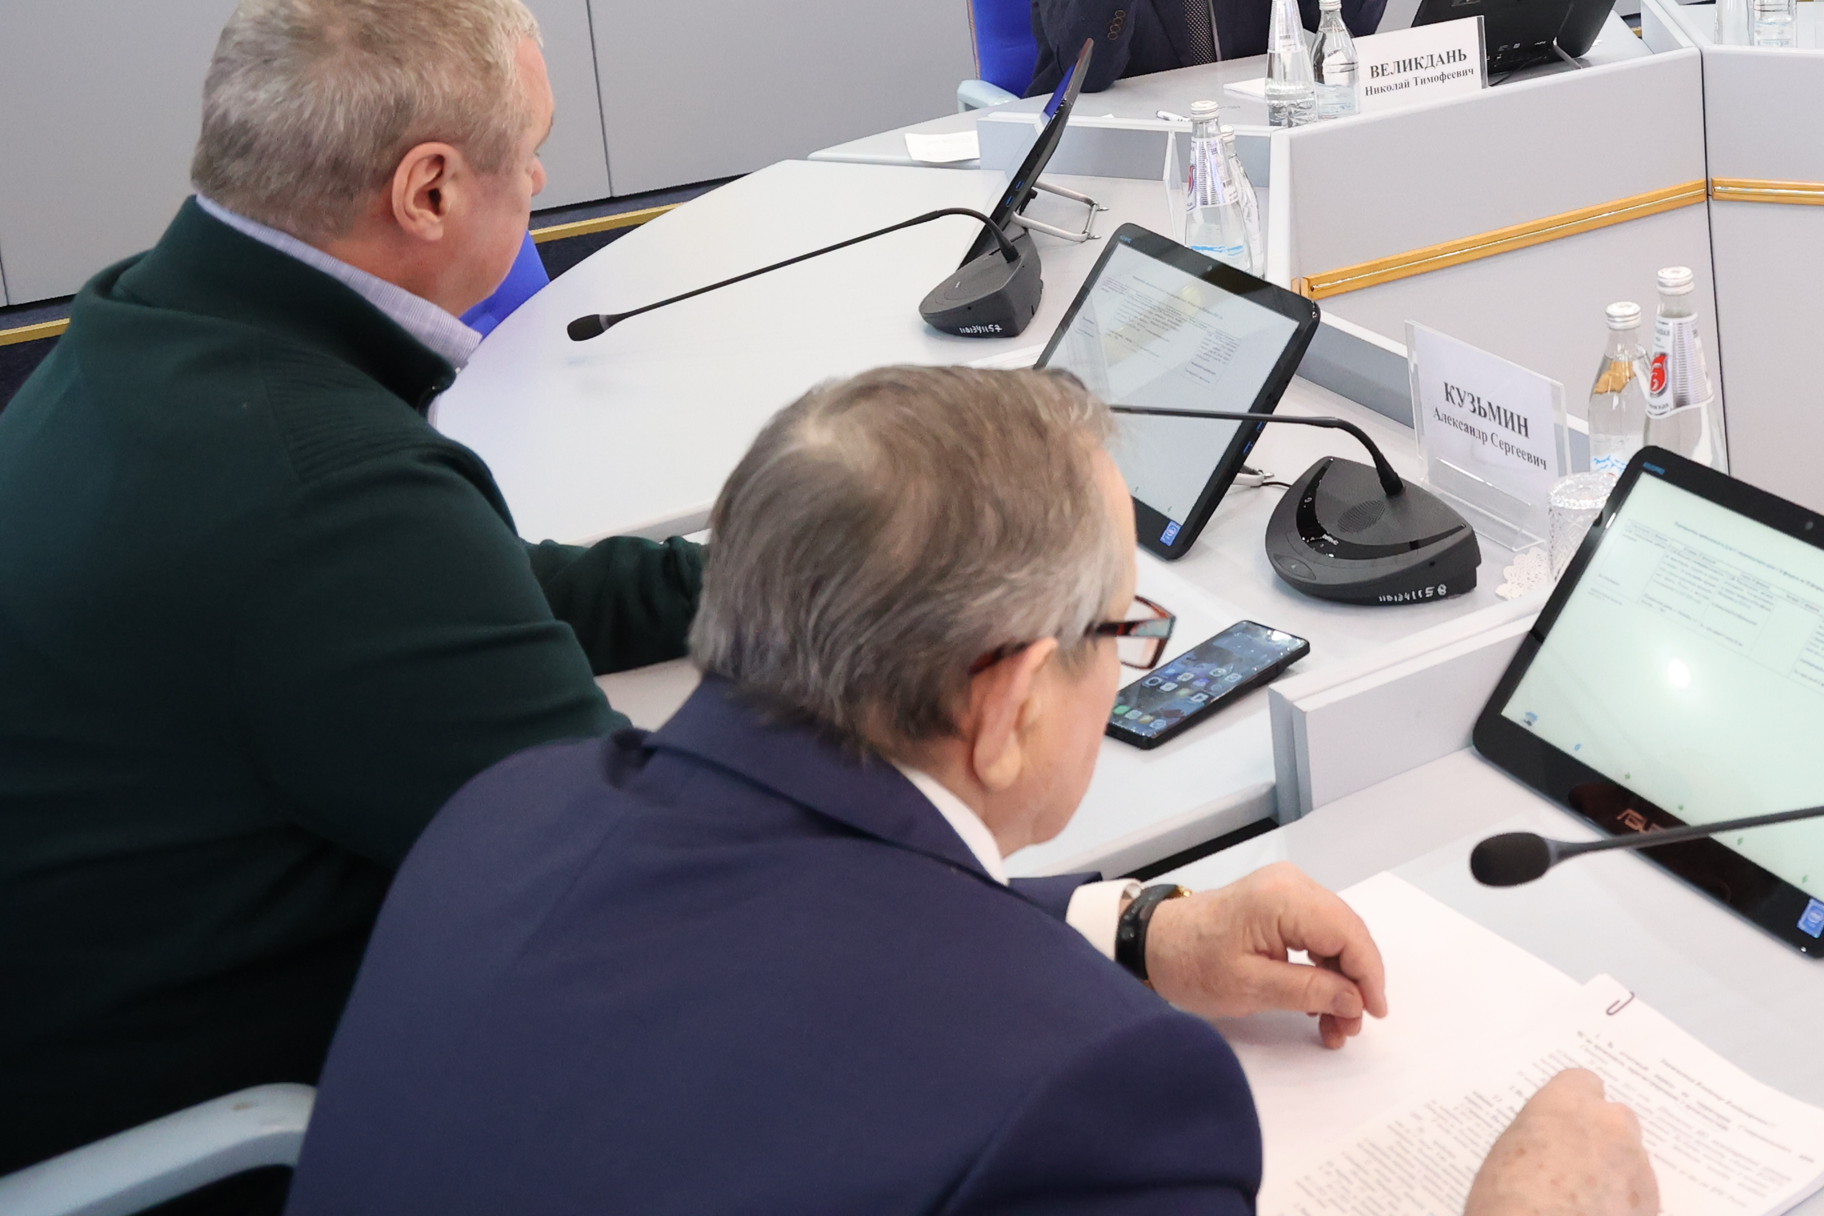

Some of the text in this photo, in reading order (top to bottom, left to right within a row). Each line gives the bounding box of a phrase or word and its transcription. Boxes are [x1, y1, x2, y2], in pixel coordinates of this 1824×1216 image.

[1365, 68, 1475, 97] Николай Тимофеевич
[1370, 48, 1468, 80] ВЕЛИКДАНЬ
[1443, 381, 1530, 439] КУЗЬМИН
[1433, 406, 1547, 471] Александр Сергеевич
